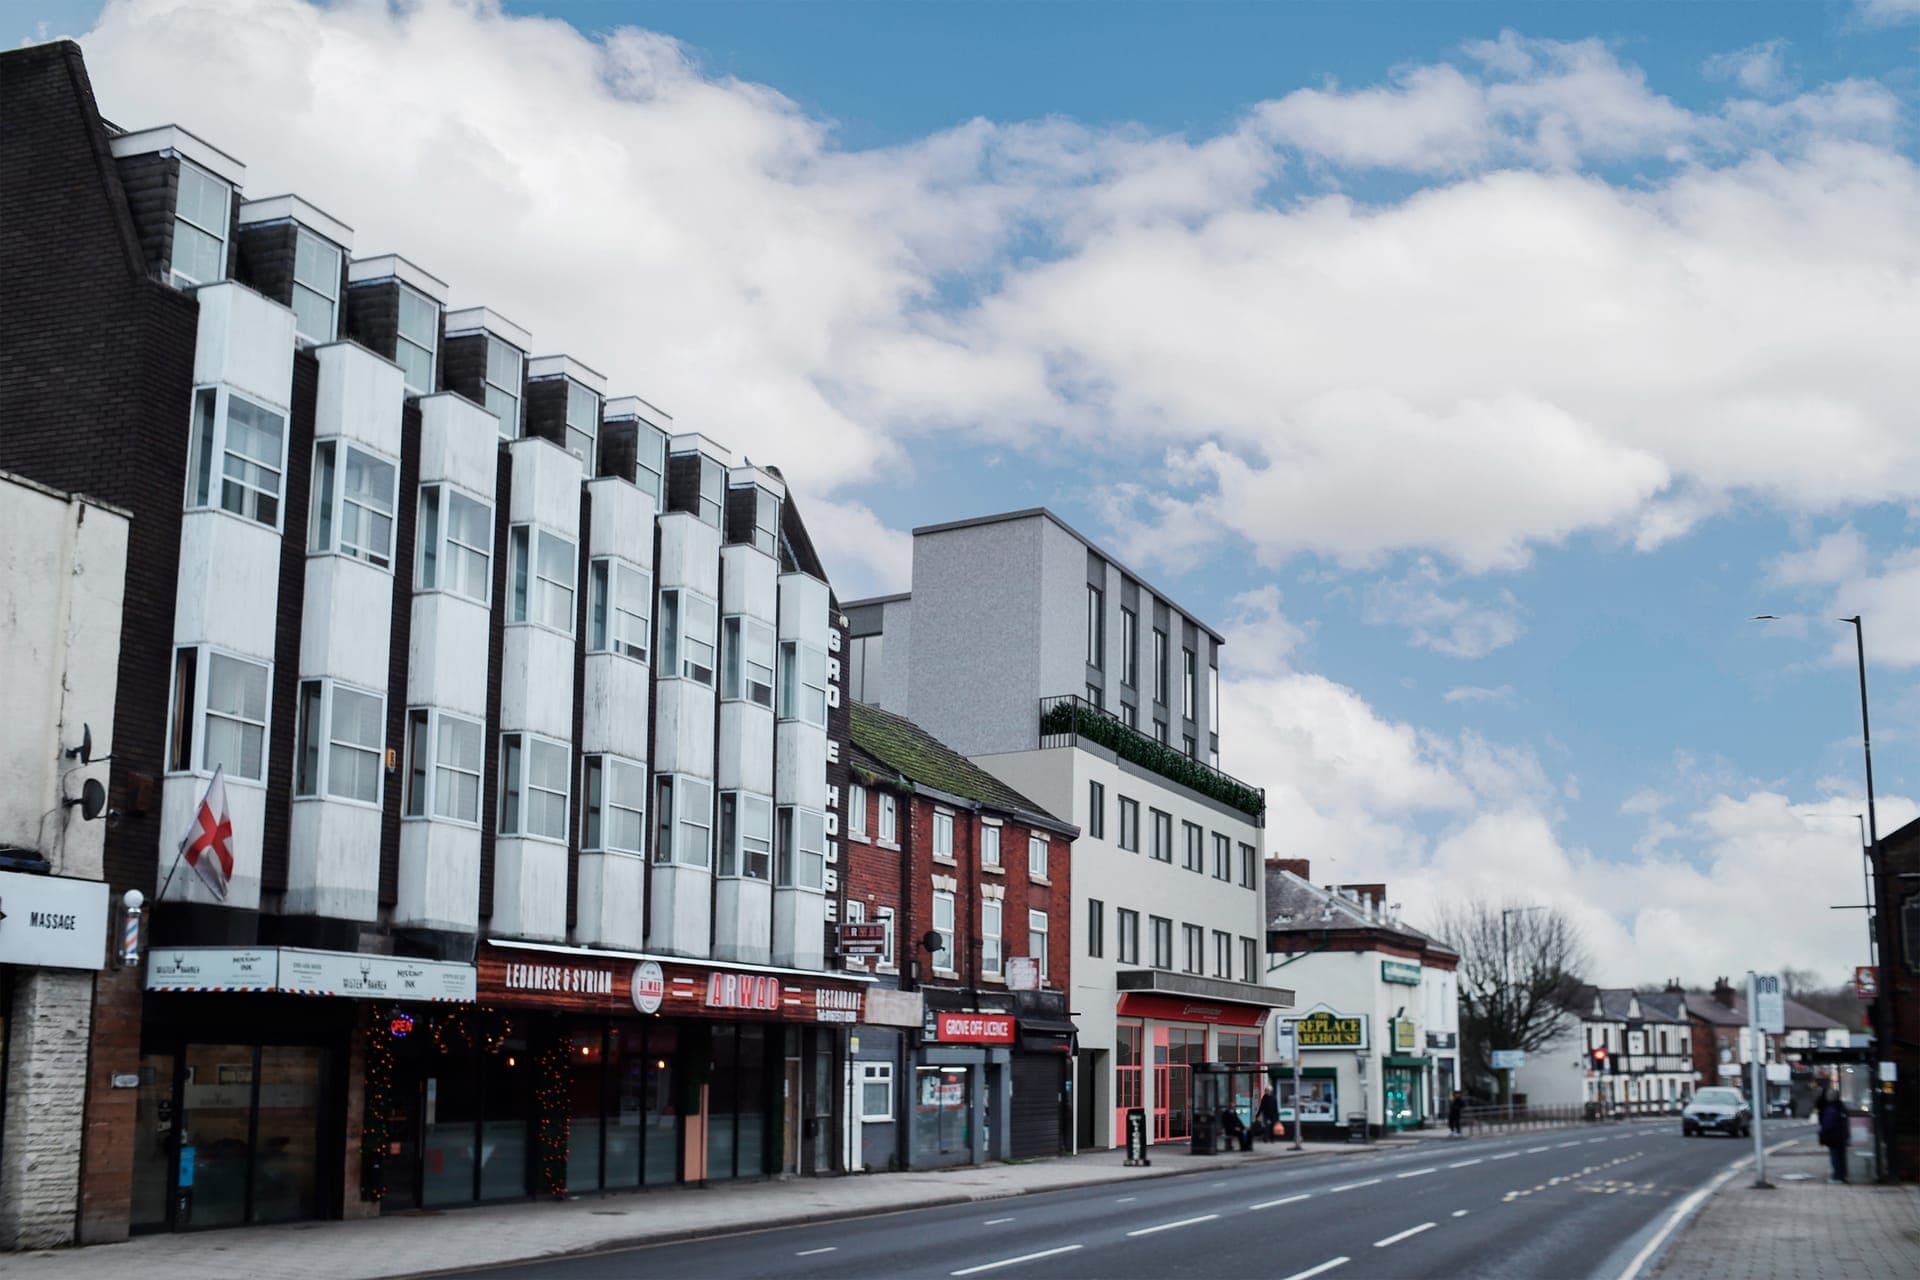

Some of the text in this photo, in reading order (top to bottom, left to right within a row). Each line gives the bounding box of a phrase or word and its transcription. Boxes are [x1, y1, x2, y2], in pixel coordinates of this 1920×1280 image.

[825, 783, 839, 922] HOUSE
[30, 911, 76, 930] MASSAGE
[506, 963, 561, 991] LEBANESE
[572, 969, 612, 993] SYRIAN
[707, 972, 780, 1010] ARWAD
[815, 988, 862, 1009] RESTAURANT
[391, 1019, 412, 1032] OPEN
[945, 1019, 969, 1035] GROVE
[969, 1020, 982, 1036] OFF
[983, 1021, 1008, 1037] LICENCE
[1298, 1020, 1359, 1032] REPLACE
[1297, 1032, 1358, 1044] AREHOUSE
